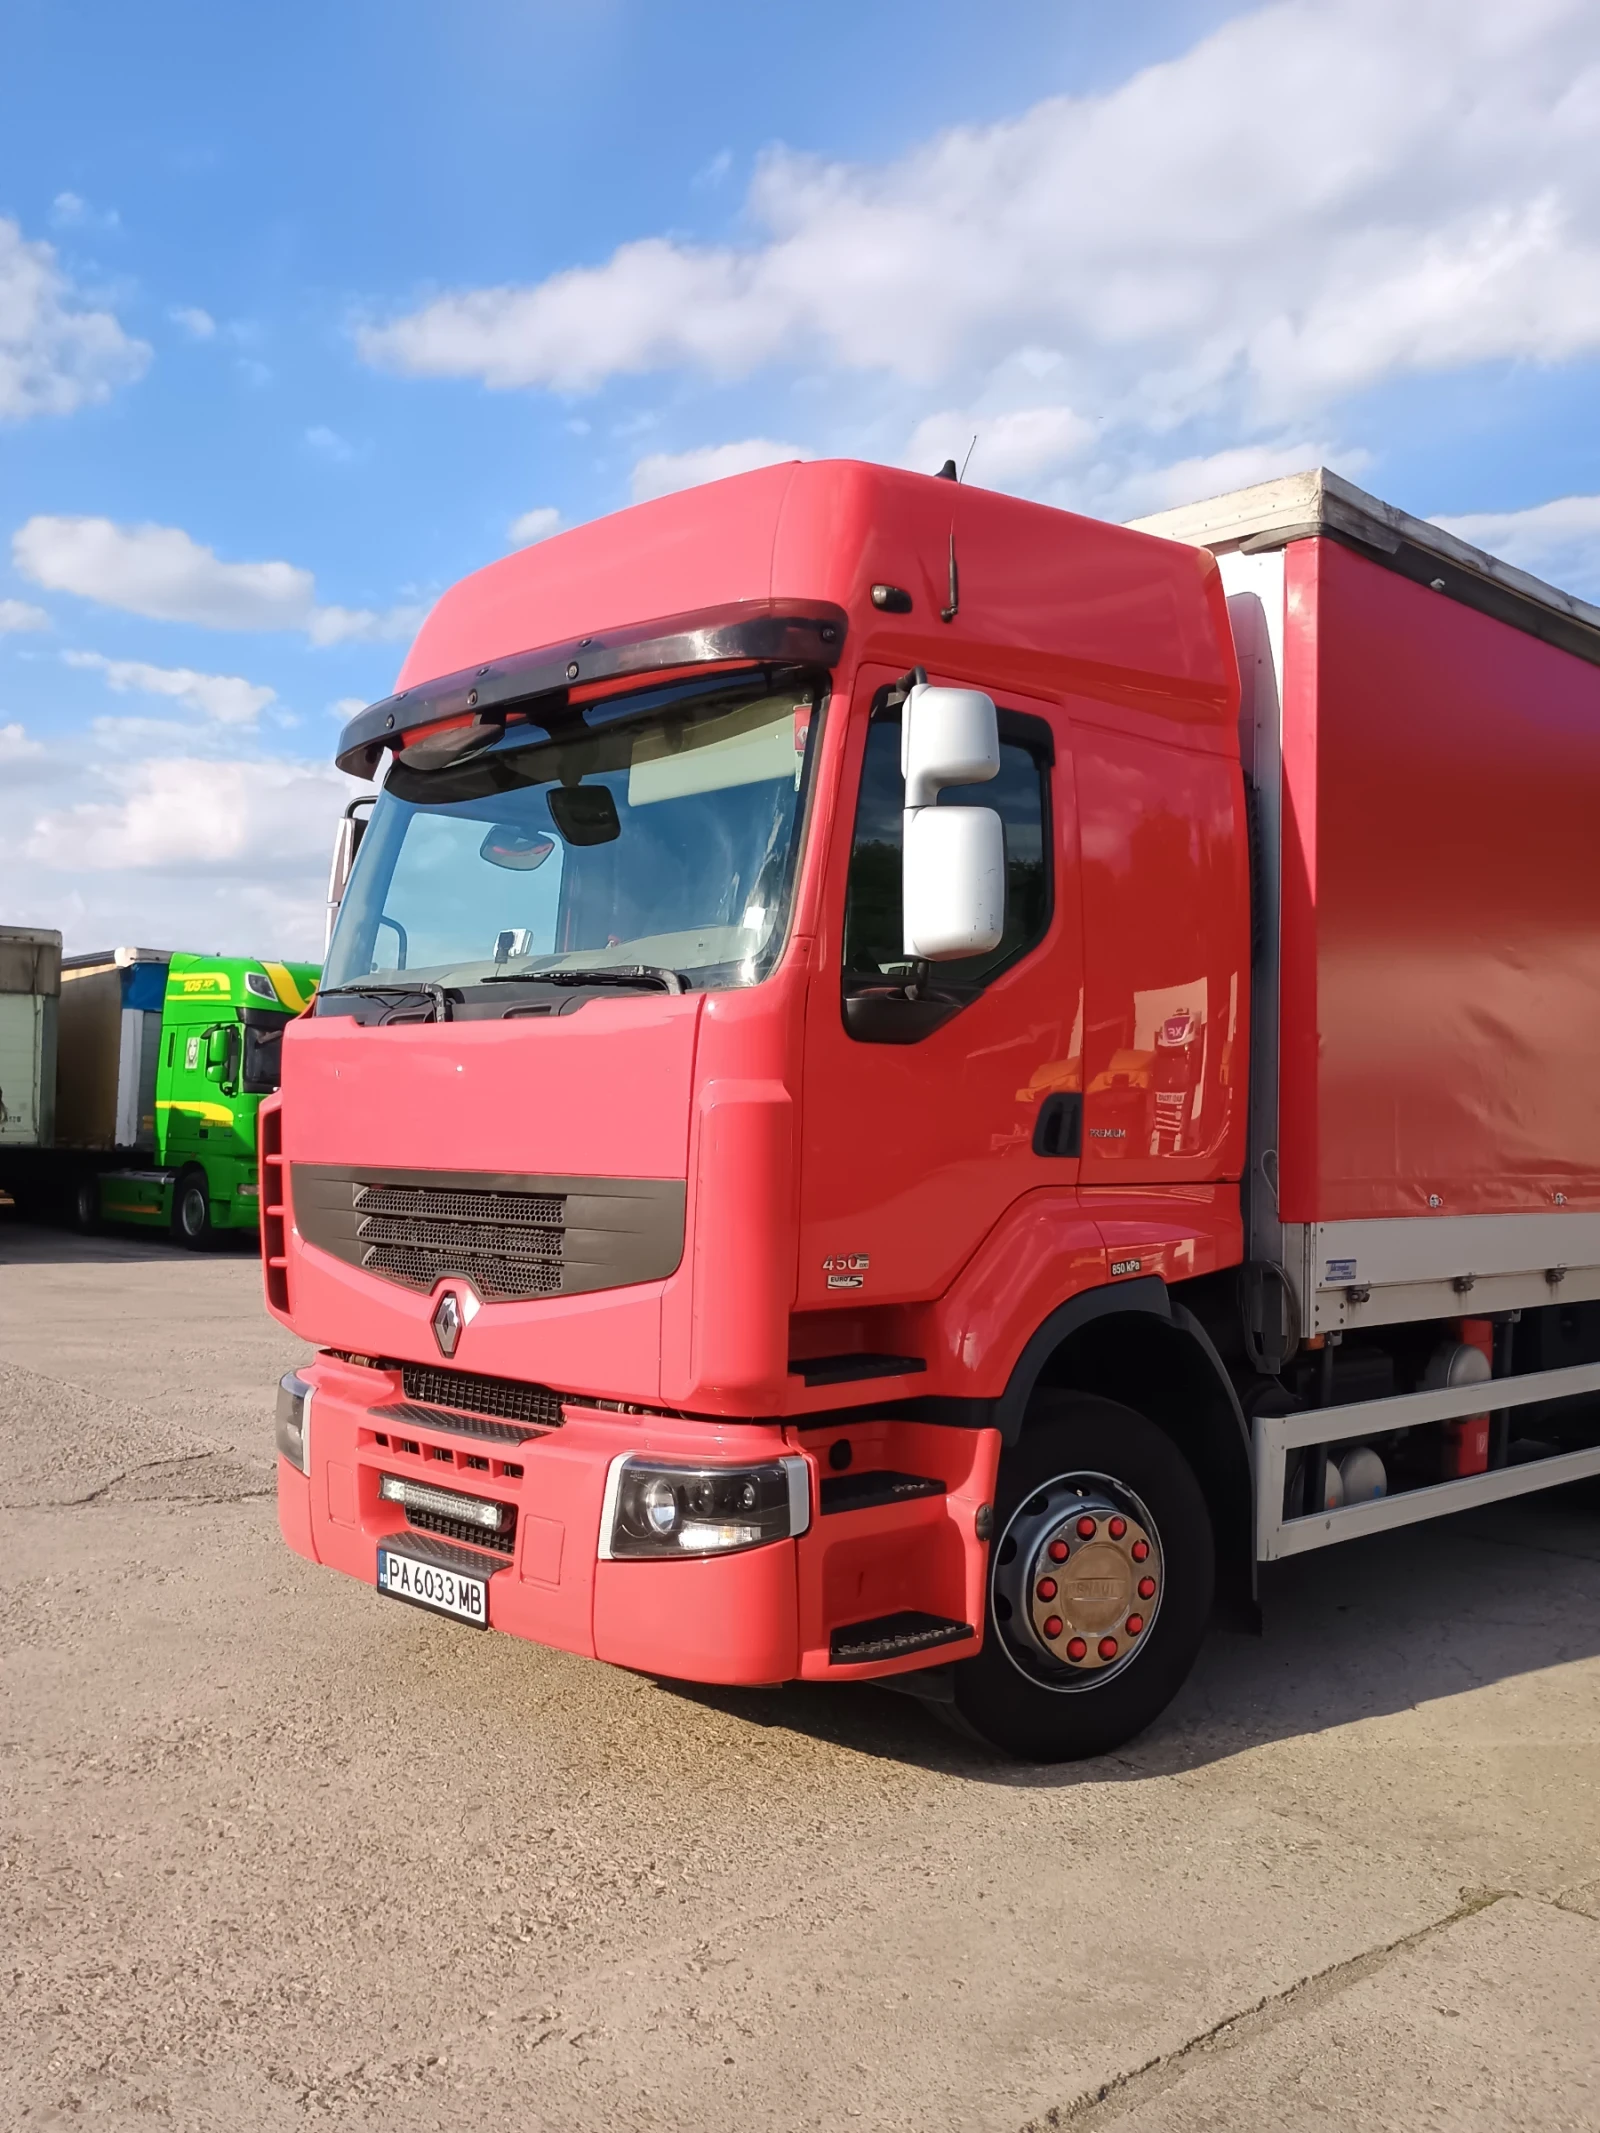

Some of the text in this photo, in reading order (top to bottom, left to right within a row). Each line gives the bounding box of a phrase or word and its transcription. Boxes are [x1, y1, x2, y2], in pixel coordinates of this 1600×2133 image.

[184, 980, 203, 992] 105
[1089, 1128, 1126, 1138] PREMIUM
[822, 1253, 858, 1270] 450
[1112, 1260, 1140, 1275] 850 kPa
